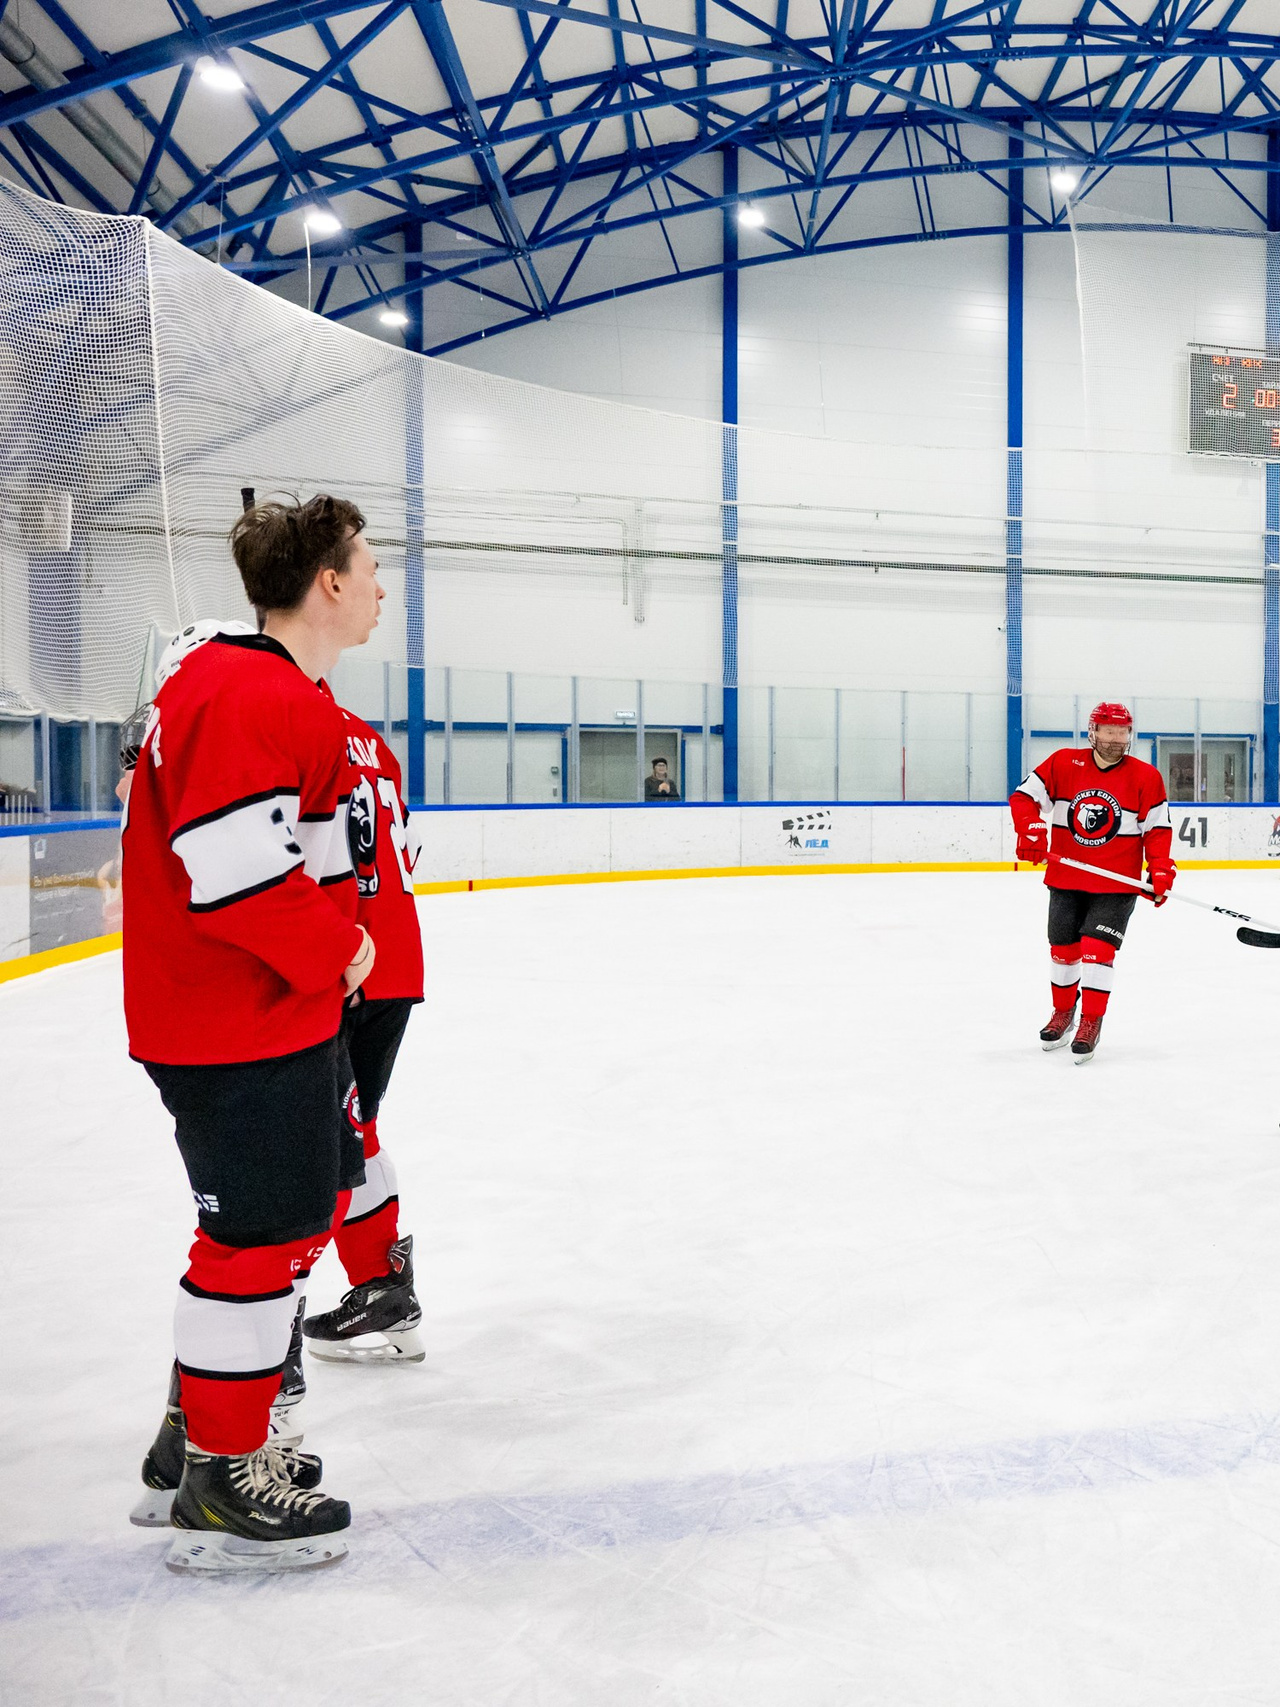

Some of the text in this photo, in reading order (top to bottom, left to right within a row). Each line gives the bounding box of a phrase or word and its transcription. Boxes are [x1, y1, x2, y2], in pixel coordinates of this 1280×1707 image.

[1223, 383, 1238, 408] 2
[1070, 790, 1121, 817] HOCKEY EDITION
[1074, 833, 1107, 846] MOSCOW
[1178, 817, 1208, 848] 41
